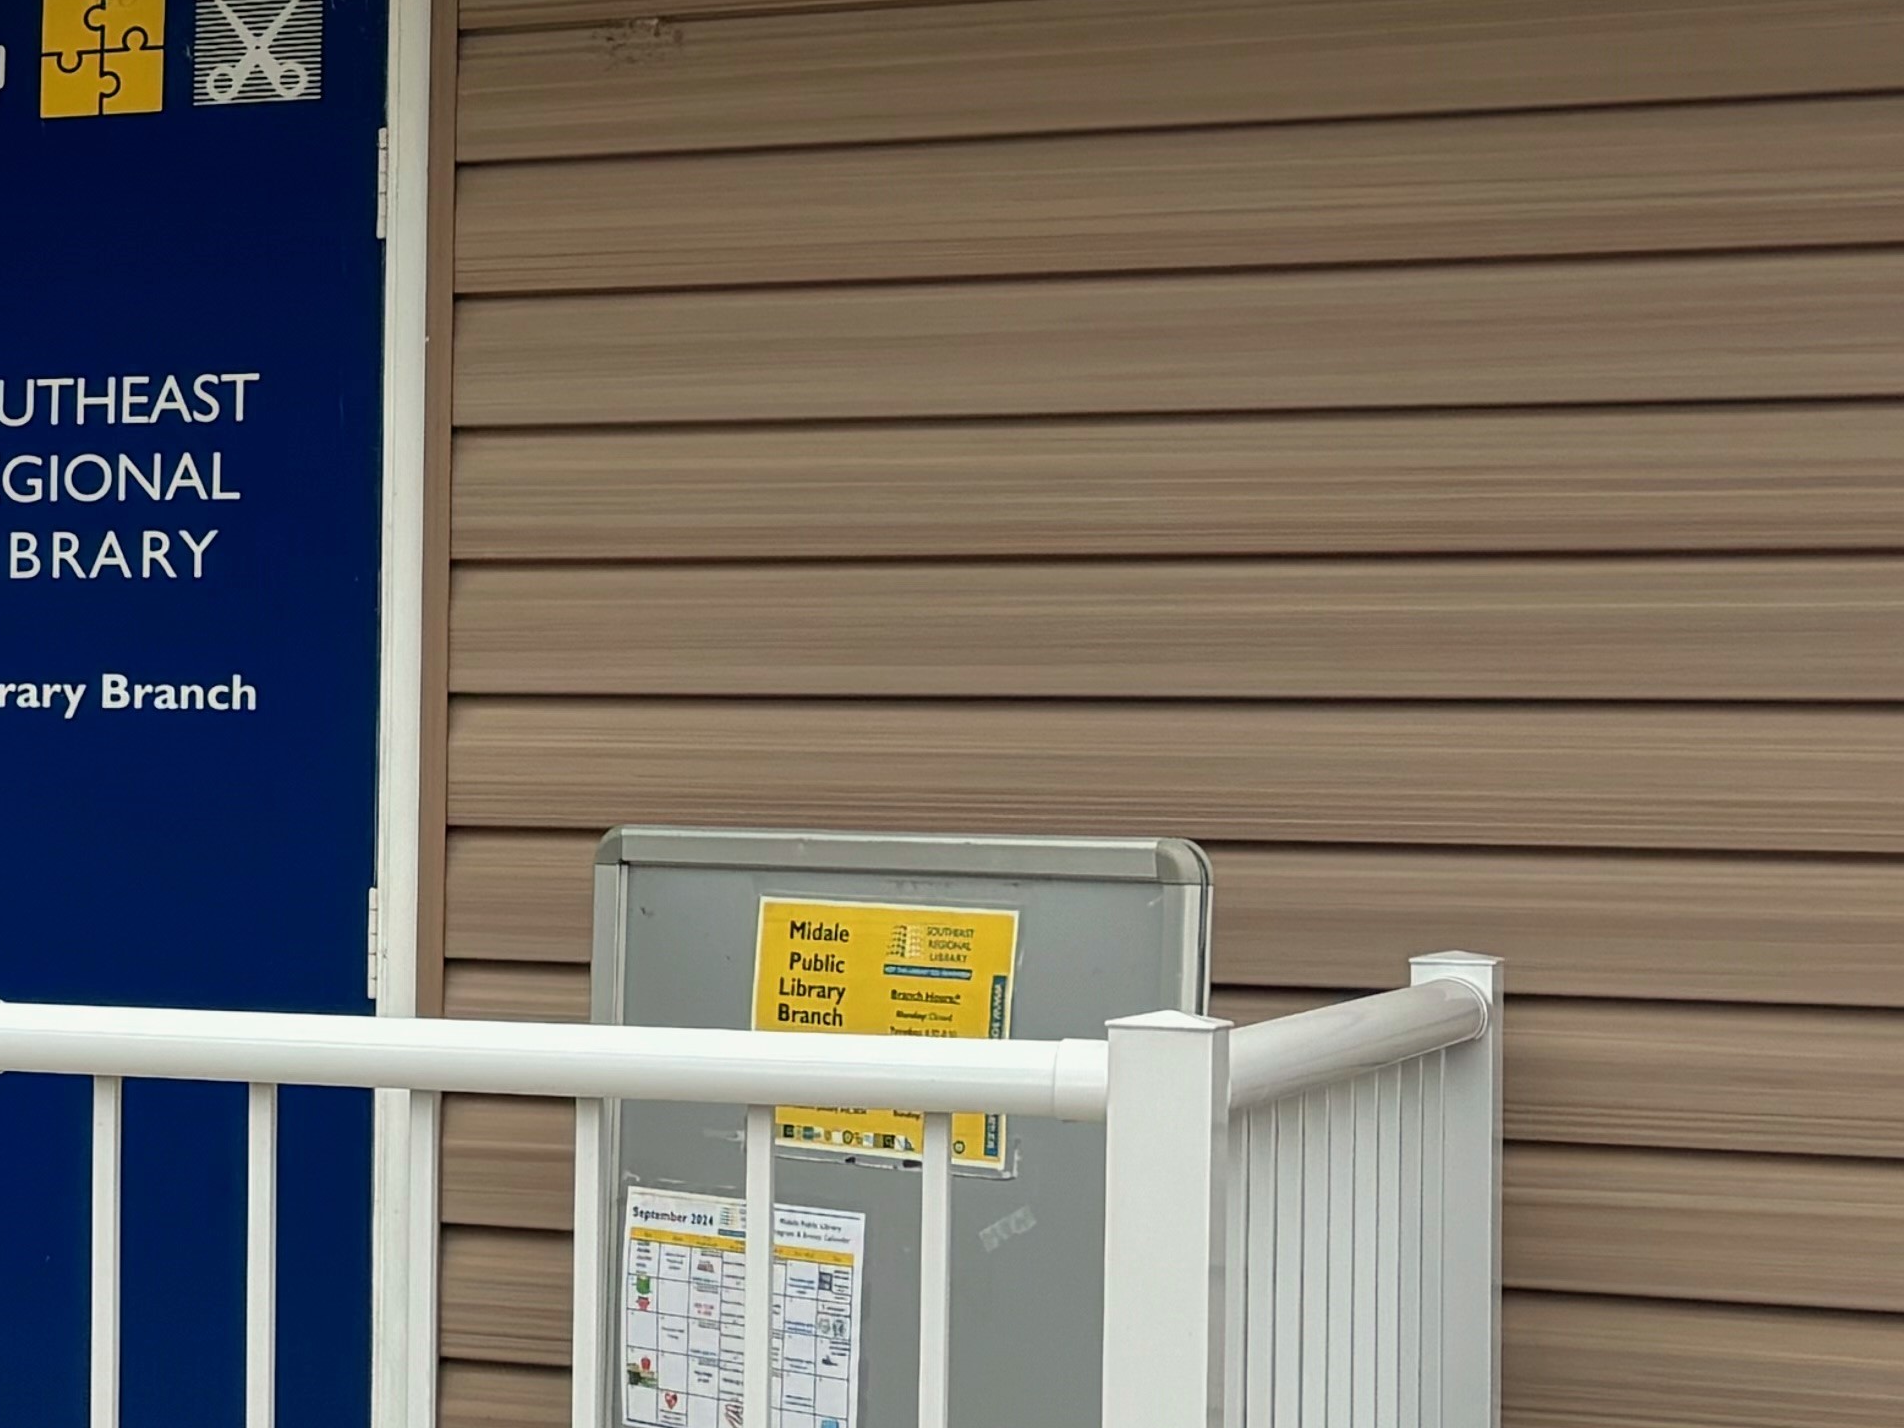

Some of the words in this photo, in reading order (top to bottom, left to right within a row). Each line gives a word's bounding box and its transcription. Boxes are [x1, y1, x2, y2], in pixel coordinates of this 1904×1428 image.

[101, 673, 257, 710] Branch
[789, 920, 850, 943] Midale
[789, 951, 846, 974] Public
[779, 976, 846, 1006] Library
[777, 1002, 843, 1028] Branch
[633, 1206, 687, 1222] September
